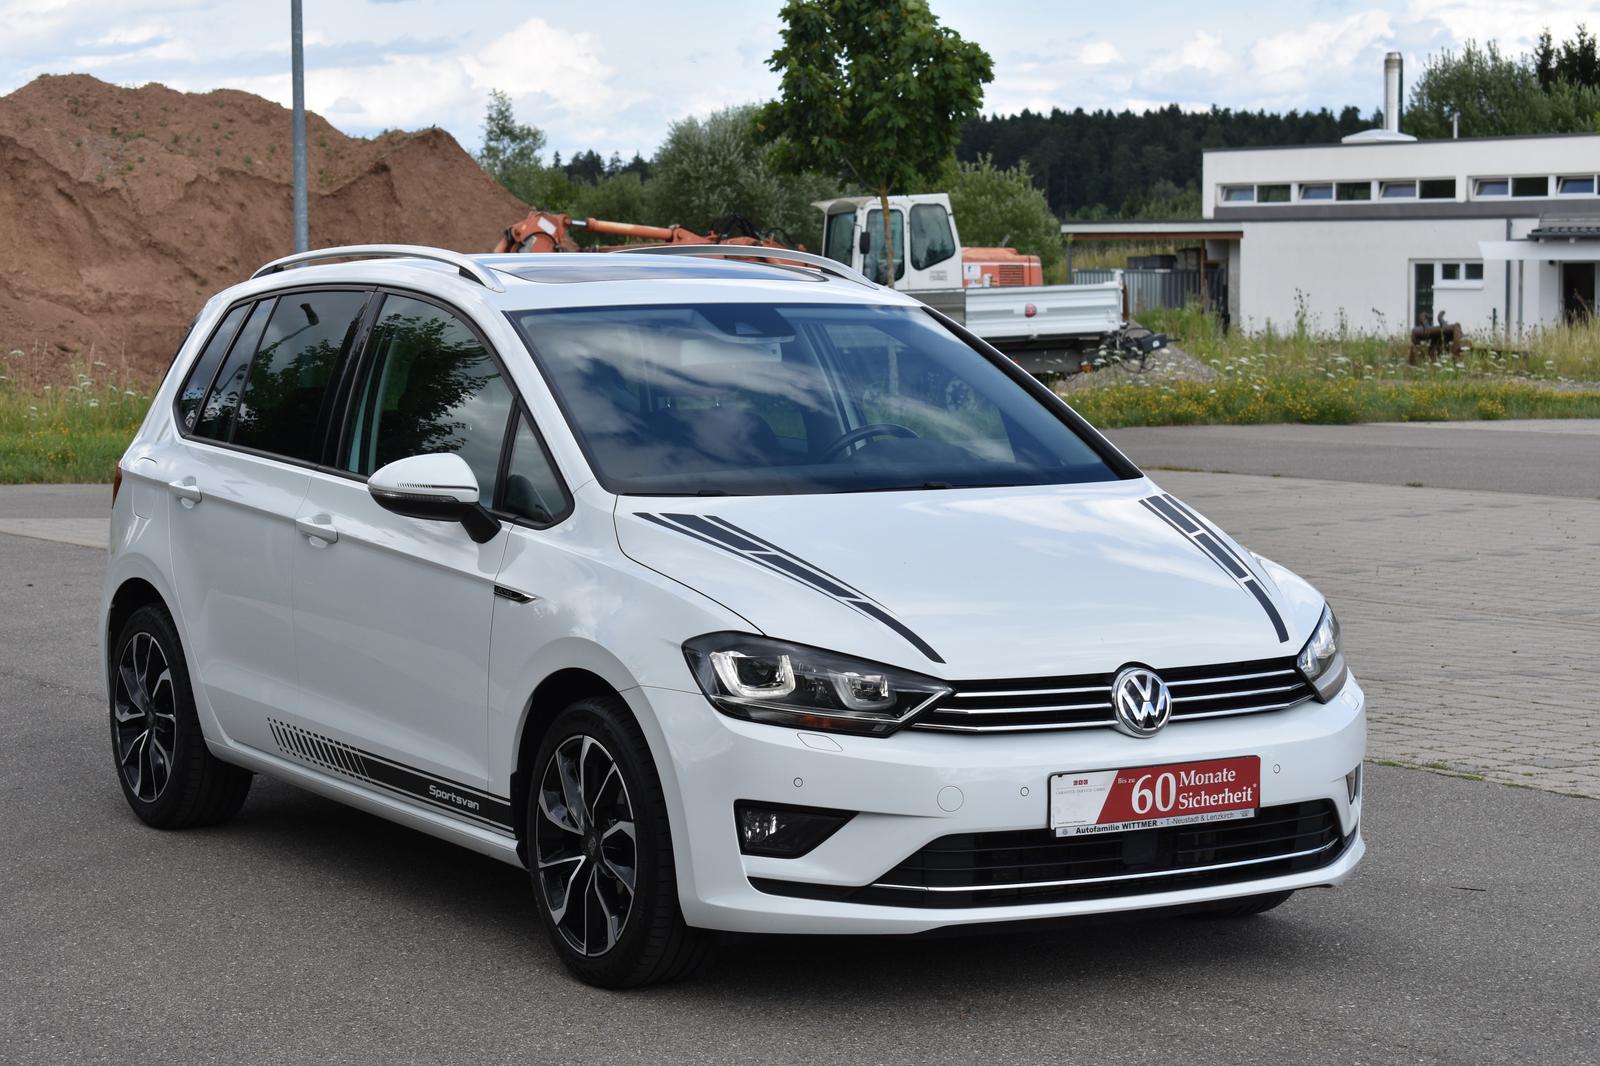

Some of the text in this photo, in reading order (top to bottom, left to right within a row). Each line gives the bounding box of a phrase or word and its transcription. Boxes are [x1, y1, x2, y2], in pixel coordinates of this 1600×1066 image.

[1114, 668, 1170, 733] VW
[1179, 768, 1236, 787] Monate
[429, 785, 480, 810] Sportsvan
[1131, 772, 1177, 815] 60
[1075, 824, 1120, 834] Autofamilie
[1122, 820, 1158, 830] WITTMER
